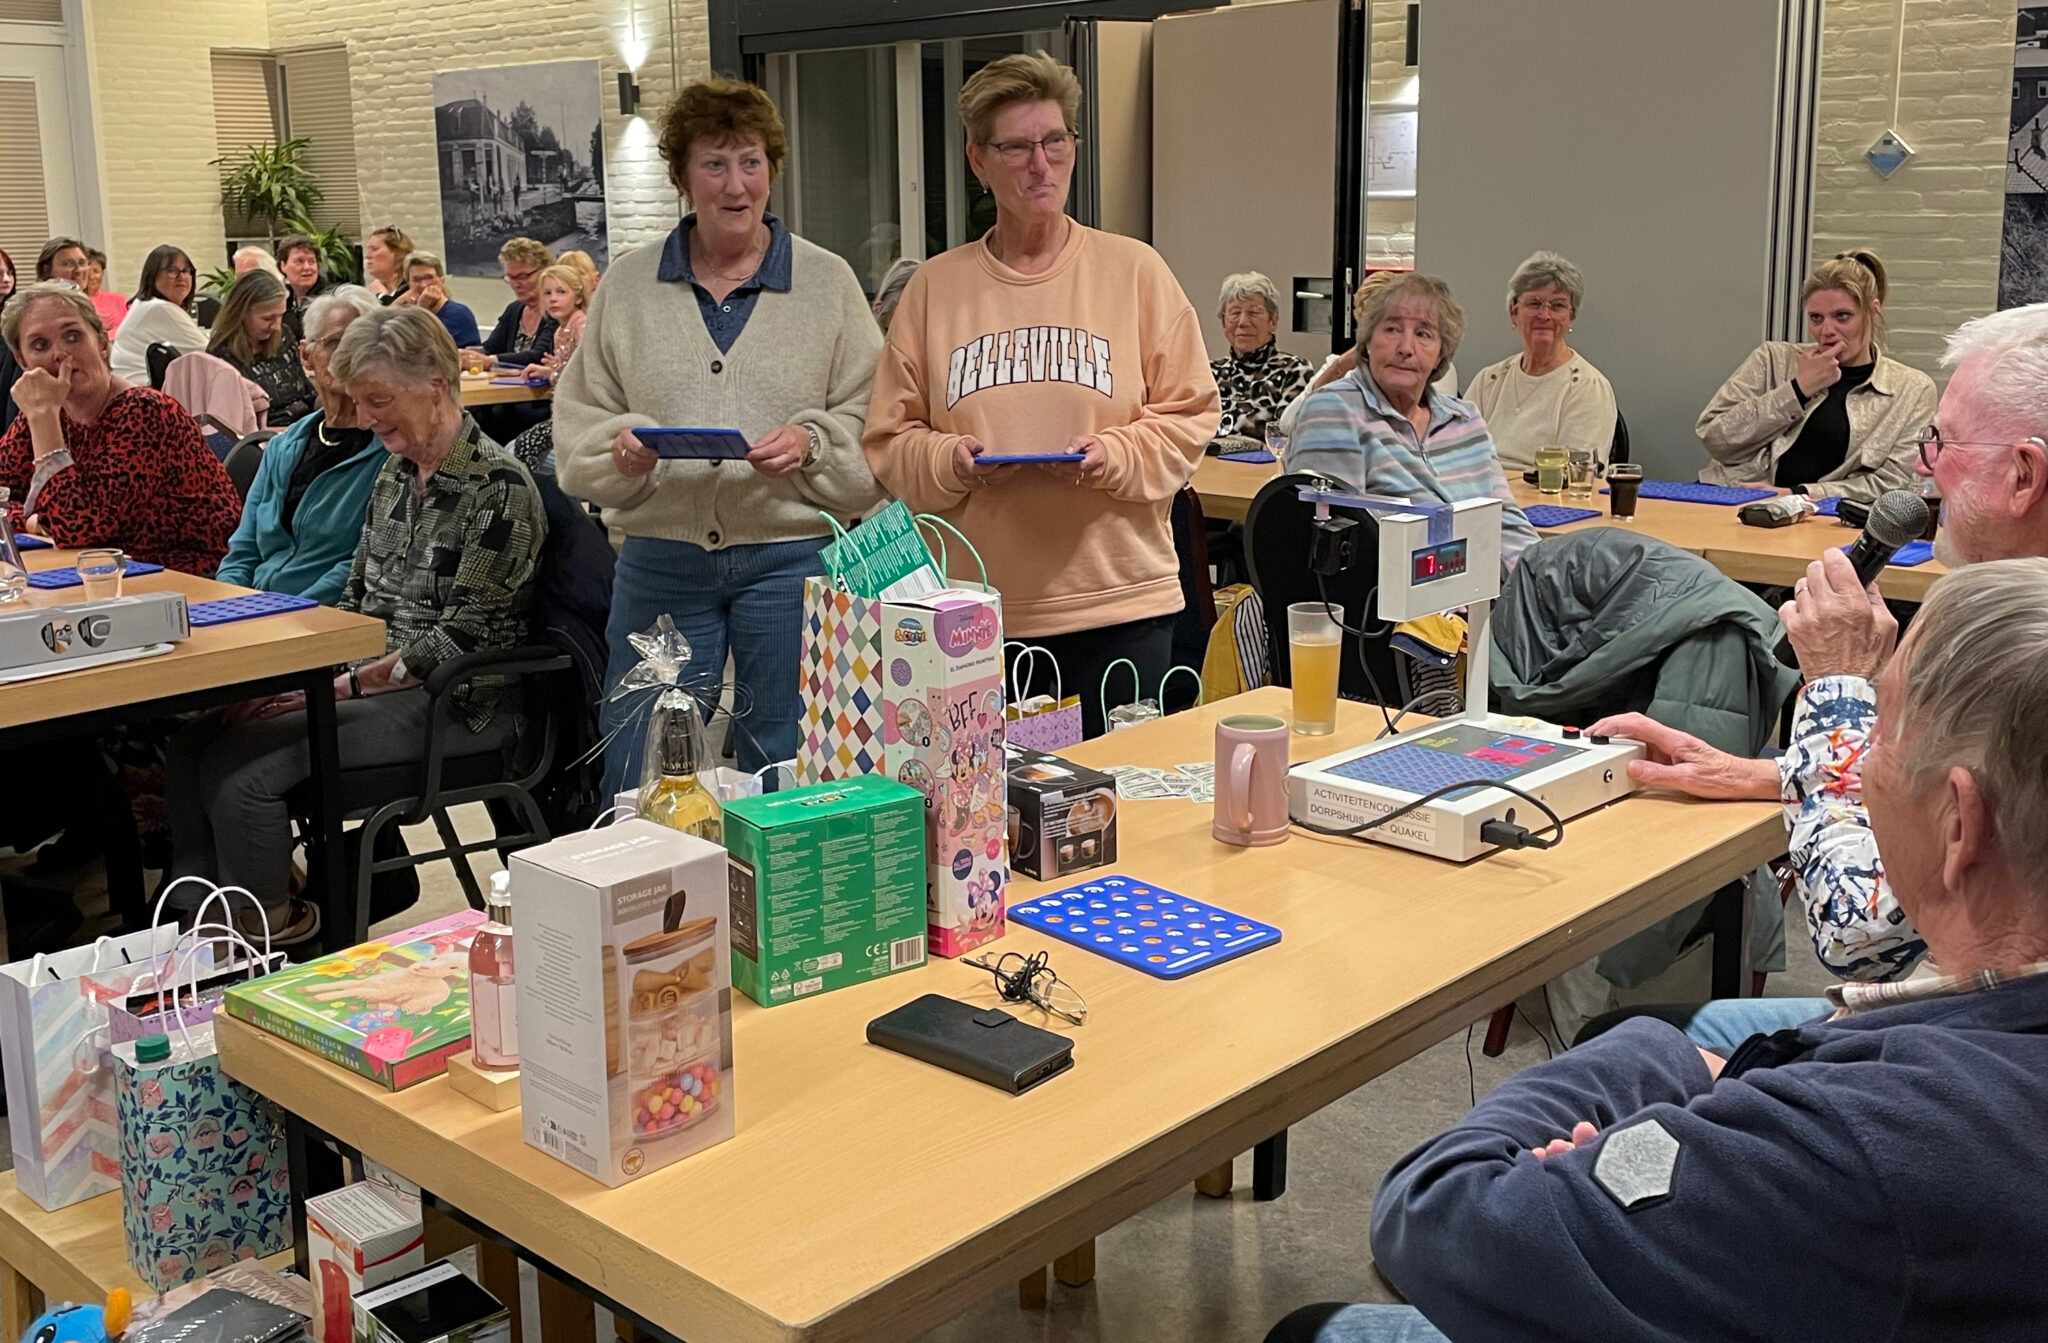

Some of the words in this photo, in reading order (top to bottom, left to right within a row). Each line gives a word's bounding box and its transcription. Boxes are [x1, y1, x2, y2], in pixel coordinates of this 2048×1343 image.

[946, 326, 1113, 411] BELLEVILLE
[949, 623, 994, 648] MINNIE
[949, 691, 977, 732] BFF
[1310, 804, 1364, 825] DORPSHUIS
[1390, 824, 1429, 841] QUAKEL
[1314, 788, 1431, 823] ACTIVITEITENCOMSSIE
[617, 888, 652, 906] STORAGE
[653, 884, 667, 896] JAR
[252, 1016, 287, 1037] DIAMOND
[290, 1033, 327, 1054] PAINTING
[329, 1050, 360, 1069] CANVAS
